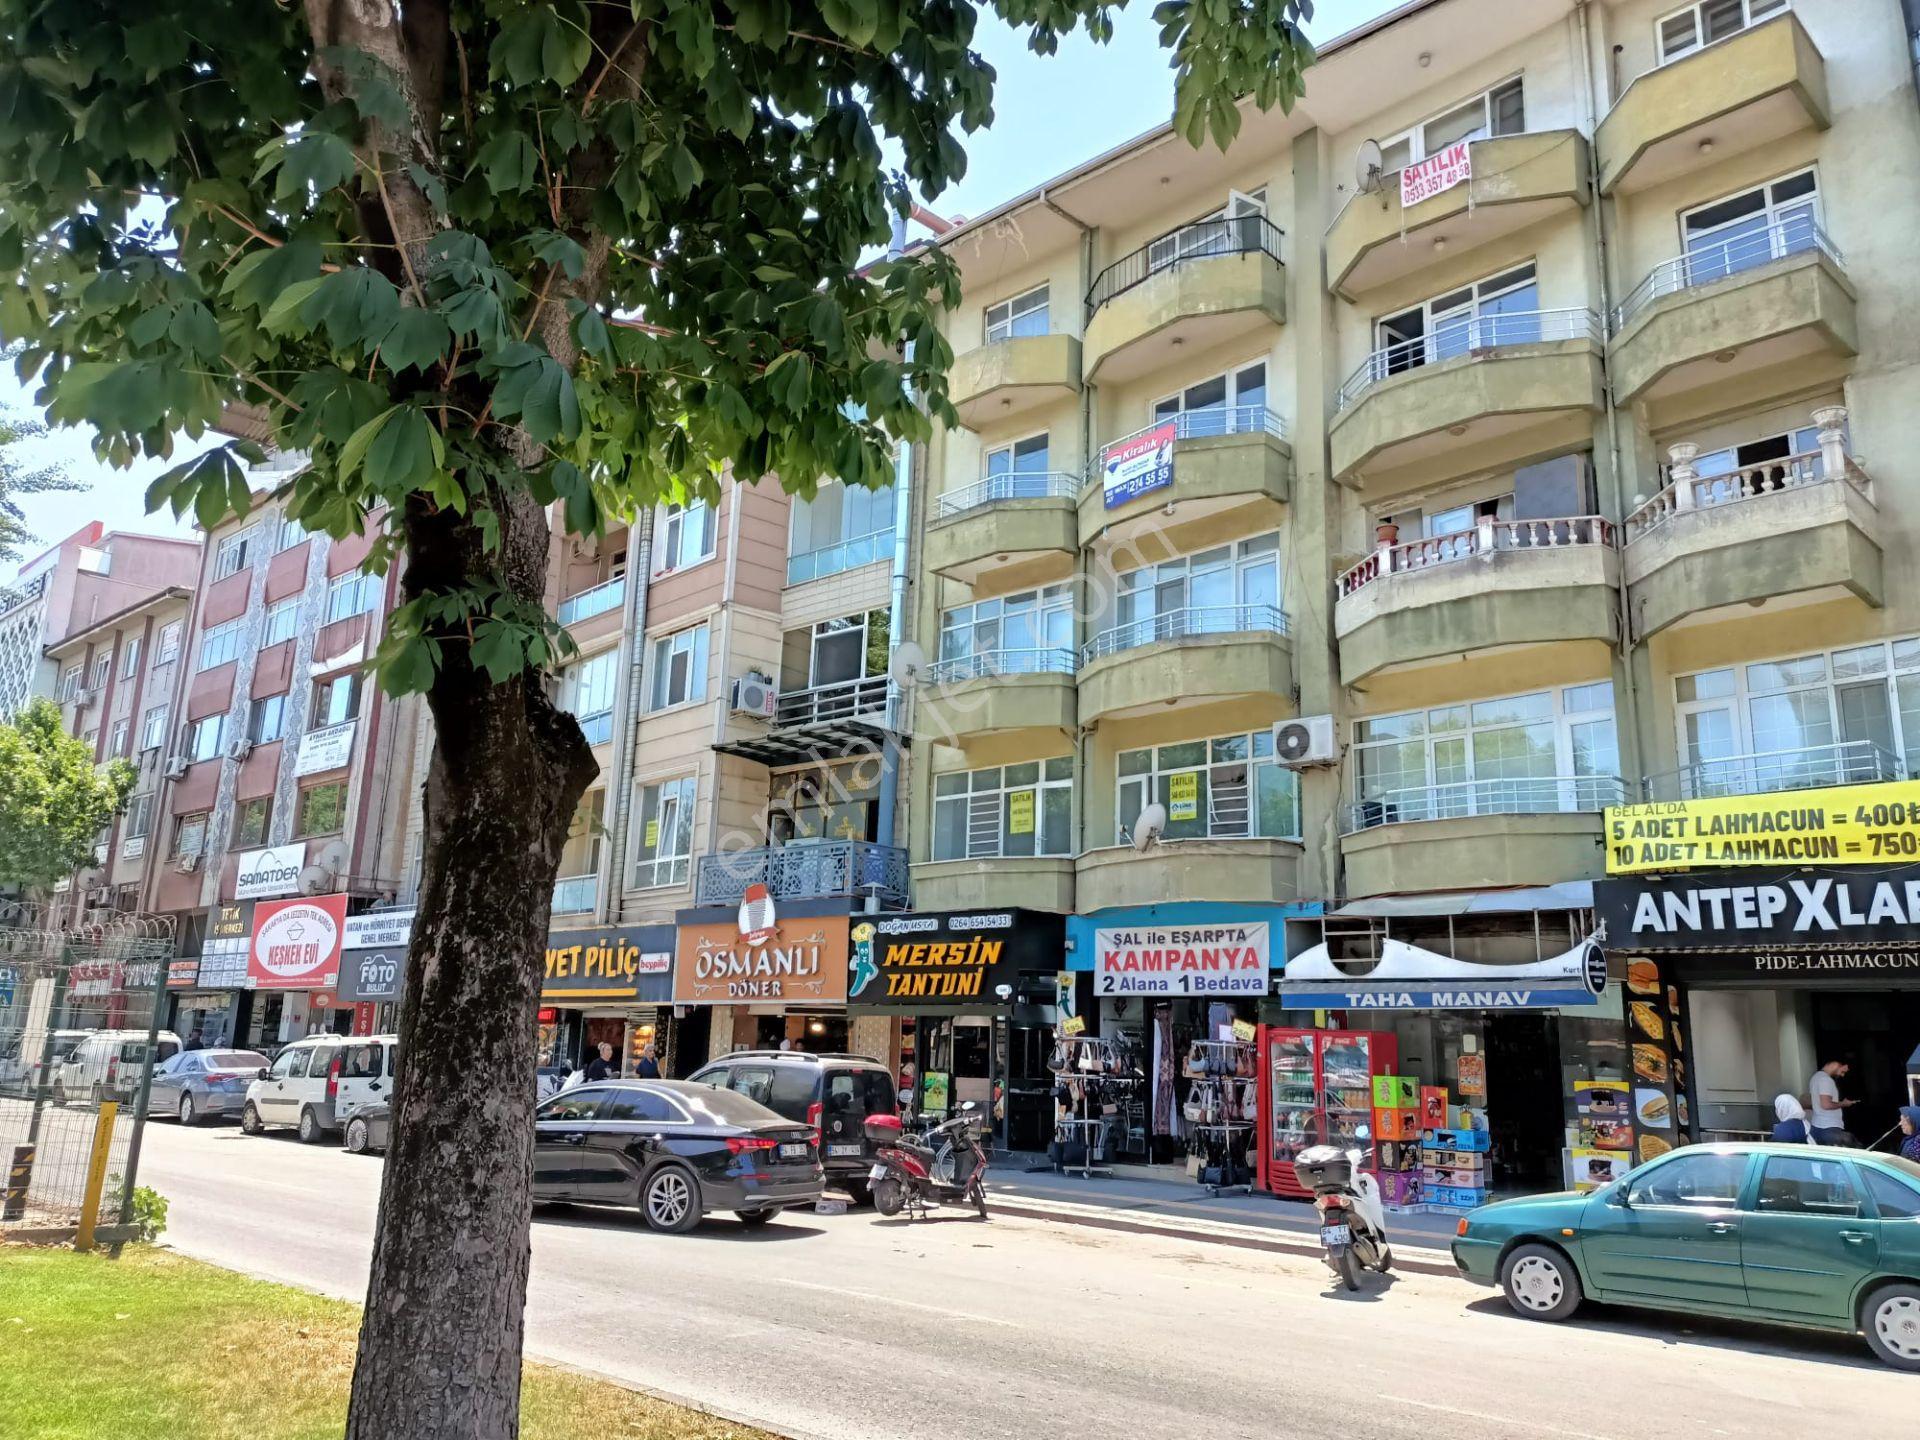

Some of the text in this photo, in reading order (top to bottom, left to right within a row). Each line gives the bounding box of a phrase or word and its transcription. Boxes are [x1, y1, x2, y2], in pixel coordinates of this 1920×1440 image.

[1404, 143, 1467, 187] SATILIK
[1404, 183, 1425, 203] 0533
[1426, 174, 1443, 193] 357
[1612, 801, 1687, 817] GEL AL'DA
[1612, 820, 1626, 839] 5
[1631, 817, 1687, 838] ADET
[1695, 808, 1825, 836] LAHMACUN
[1614, 844, 1634, 866] 10
[1640, 841, 1698, 863] ADET
[1705, 835, 1838, 860] LAHMACUN
[1867, 831, 1920, 856] 750
[239, 866, 299, 887] SAMATDER
[221, 904, 241, 920] TETİK
[879, 919, 934, 934] DOĞAN USTA
[361, 933, 377, 944] GENEL
[1113, 928, 1247, 947] ŞAL ile EŞARPTA
[267, 943, 301, 970] KEŞKEK
[584, 937, 640, 984] PİLİÇ
[882, 936, 1004, 966] MERSİN
[1104, 947, 1260, 972] KAMPANYA
[1755, 952, 1920, 970] PİDE-LAHMACUN
[361, 965, 395, 983] FOTO
[886, 967, 984, 996] TANTUNİ
[1103, 974, 1263, 993] 2 Alana 1 Bedava
[366, 983, 386, 993] BULUT
[728, 980, 782, 997] DÖNER
[1345, 991, 1532, 1007] TAHA MANAV
